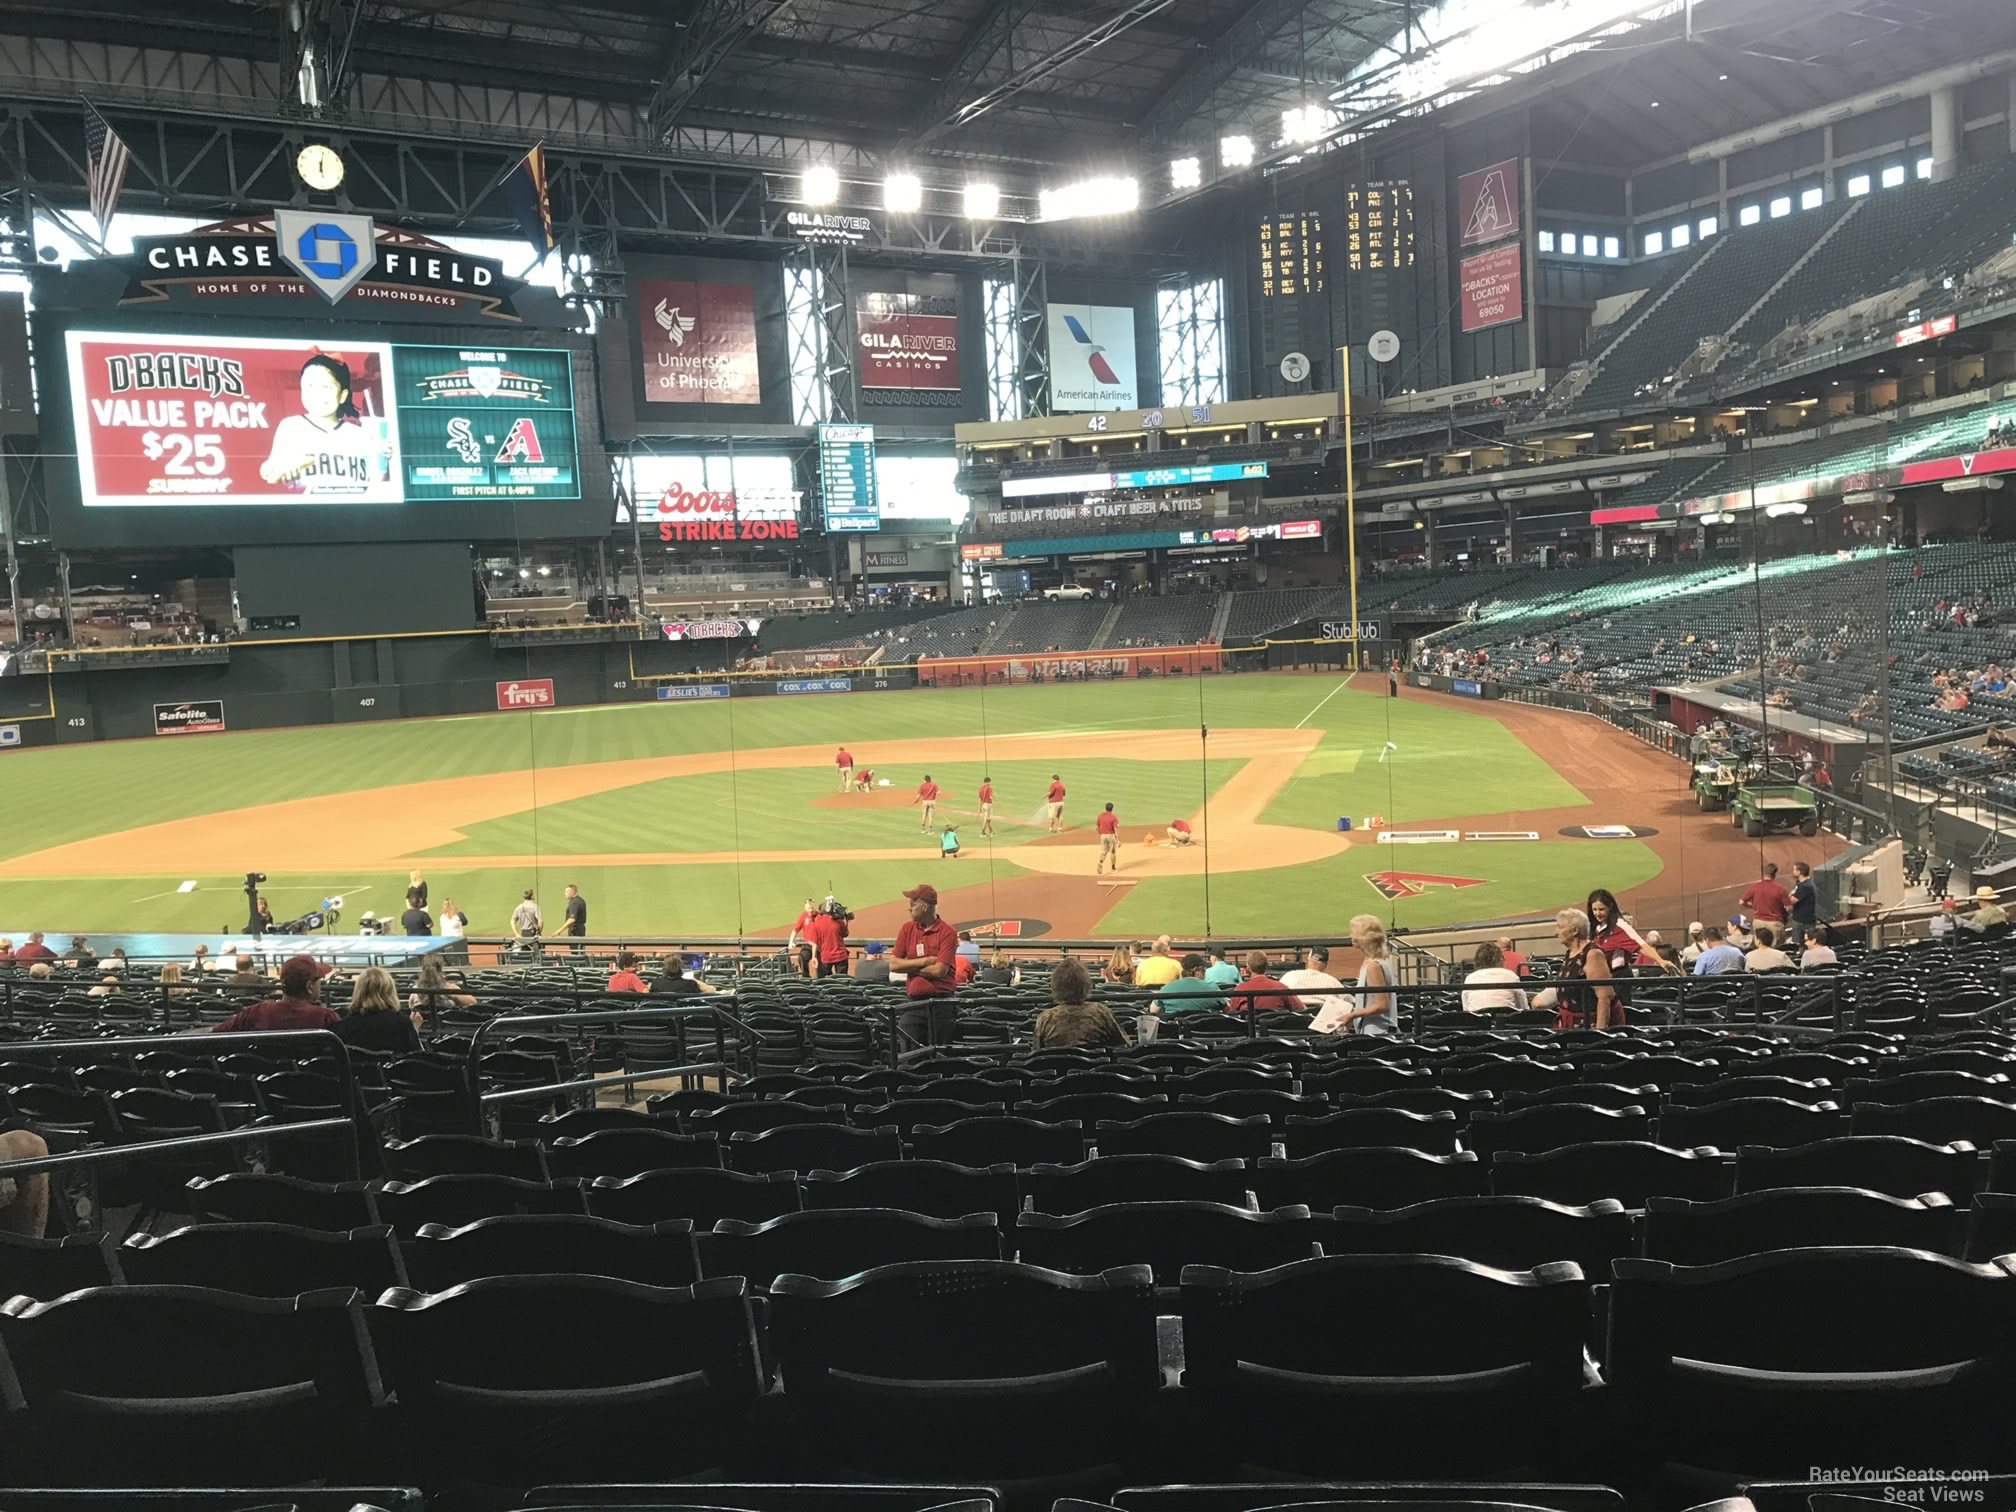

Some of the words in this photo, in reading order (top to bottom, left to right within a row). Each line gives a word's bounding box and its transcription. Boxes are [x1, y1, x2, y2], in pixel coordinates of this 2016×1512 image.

[1348, 192, 1359, 201] 37
[787, 211, 824, 227] GILA
[823, 214, 871, 230] RIVER
[1348, 212, 1359, 221] 43
[1392, 218, 1398, 226] 2
[1260, 223, 1271, 231] 44
[1301, 220, 1307, 228] 6
[1261, 231, 1271, 240] 63
[1301, 228, 1307, 236] 6
[1369, 232, 1382, 240] PIT
[804, 236, 857, 246] CASINOS
[1261, 242, 1272, 251] 51
[1302, 239, 1308, 248] 2
[1349, 242, 1360, 250] 26
[1302, 247, 1308, 256] 3
[1349, 253, 1360, 262] 50
[1394, 250, 1400, 259] 3
[148, 245, 272, 269] CHASE
[386, 253, 492, 287] FIELD
[1303, 258, 1309, 267] 2
[1394, 259, 1400, 267] 0
[1262, 269, 1273, 278] 23
[1303, 266, 1309, 275] 2
[1263, 280, 1273, 289] 32
[1303, 277, 1309, 286] 0
[197, 284, 239, 294] HOME
[250, 284, 268, 293] OF
[278, 284, 305, 293] THE
[357, 288, 456, 306] DIAMONDBACKS
[1472, 283, 1510, 302] LOCATION
[1479, 303, 1504, 318] 69050
[861, 333, 902, 349] GILA
[903, 335, 956, 351] RIVER
[875, 361, 941, 370] CASINOS
[430, 378, 468, 389] CHASE
[502, 380, 540, 391] FIELD
[660, 372, 676, 388] of
[1056, 389, 1099, 400] American
[1100, 390, 1132, 401] Airlines
[91, 398, 188, 428] VALUE
[193, 400, 269, 429] PACK
[1141, 412, 1163, 427] 20
[1192, 406, 1211, 424] 51
[1088, 415, 1108, 432] 42
[142, 430, 226, 476] $25
[498, 486, 507, 495] AT
[657, 481, 736, 513] Coors
[988, 513, 1008, 524] THE
[1010, 509, 1044, 523] DRAFT
[1046, 507, 1076, 521] ROOM
[1094, 504, 1126, 518] CRAFT
[1129, 501, 1156, 515] BEER
[659, 521, 737, 541] STRIKE
[740, 520, 799, 540] ZONE
[880, 556, 907, 565] FITNESS
[614, 681, 627, 689] 413
[783, 683, 800, 691] COX
[807, 682, 824, 690] COX
[829, 681, 847, 689] COX
[503, 683, 549, 705] fry's
[667, 687, 698, 697] LESLIE'S
[360, 698, 375, 707] 407
[159, 710, 207, 721] Safelite
[186, 717, 220, 725] AutoGlass
[68, 718, 85, 727] 413
